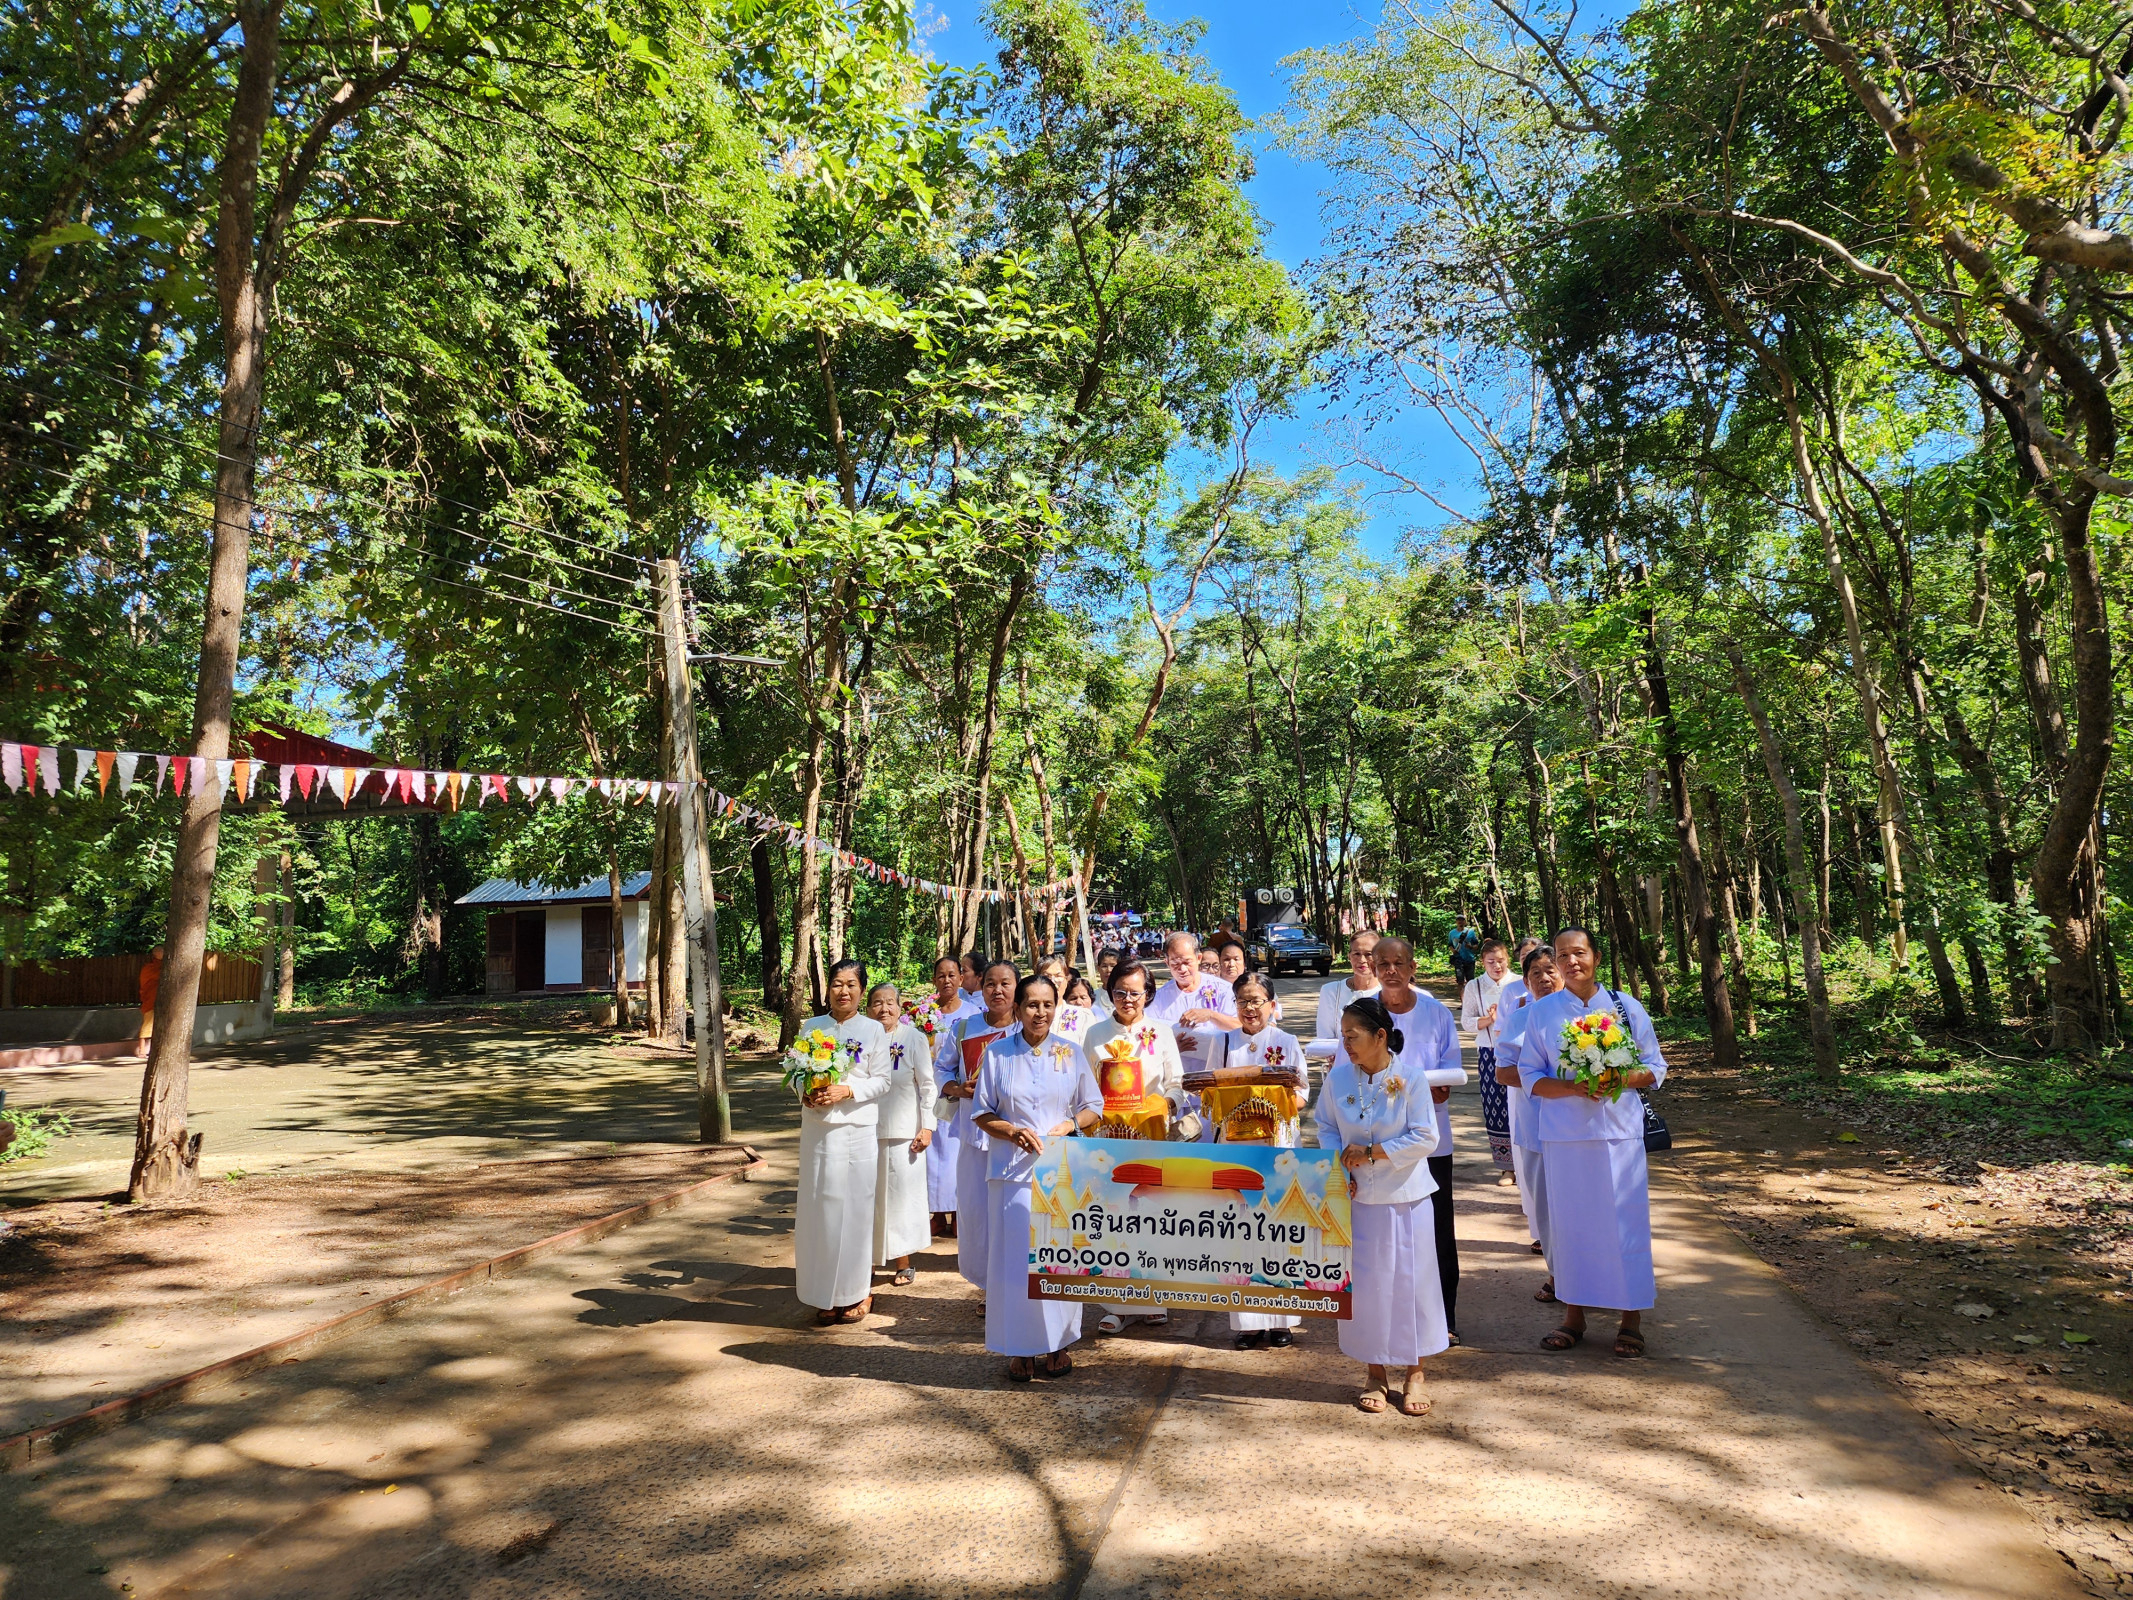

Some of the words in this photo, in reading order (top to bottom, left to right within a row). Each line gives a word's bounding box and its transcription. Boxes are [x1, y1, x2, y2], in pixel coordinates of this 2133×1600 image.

[1613, 1000, 1628, 1023] LOVE
[1071, 1203, 1306, 1243] กฐินสามัคคีทั่วไทย
[1038, 1247, 1130, 1269] ๓๐,๐๐๐
[1137, 1250, 1157, 1269] วัด
[1163, 1254, 1253, 1276] พุทธศักราช
[1261, 1257, 1342, 1281] ๒๕๖๘
[1040, 1281, 1061, 1293] โดย
[1064, 1283, 1150, 1301] คณะศิษยานุศิษย์
[1154, 1290, 1207, 1304] บูชาธรรม
[1211, 1296, 1227, 1305] ๘๑
[1232, 1292, 1240, 1304] ปี
